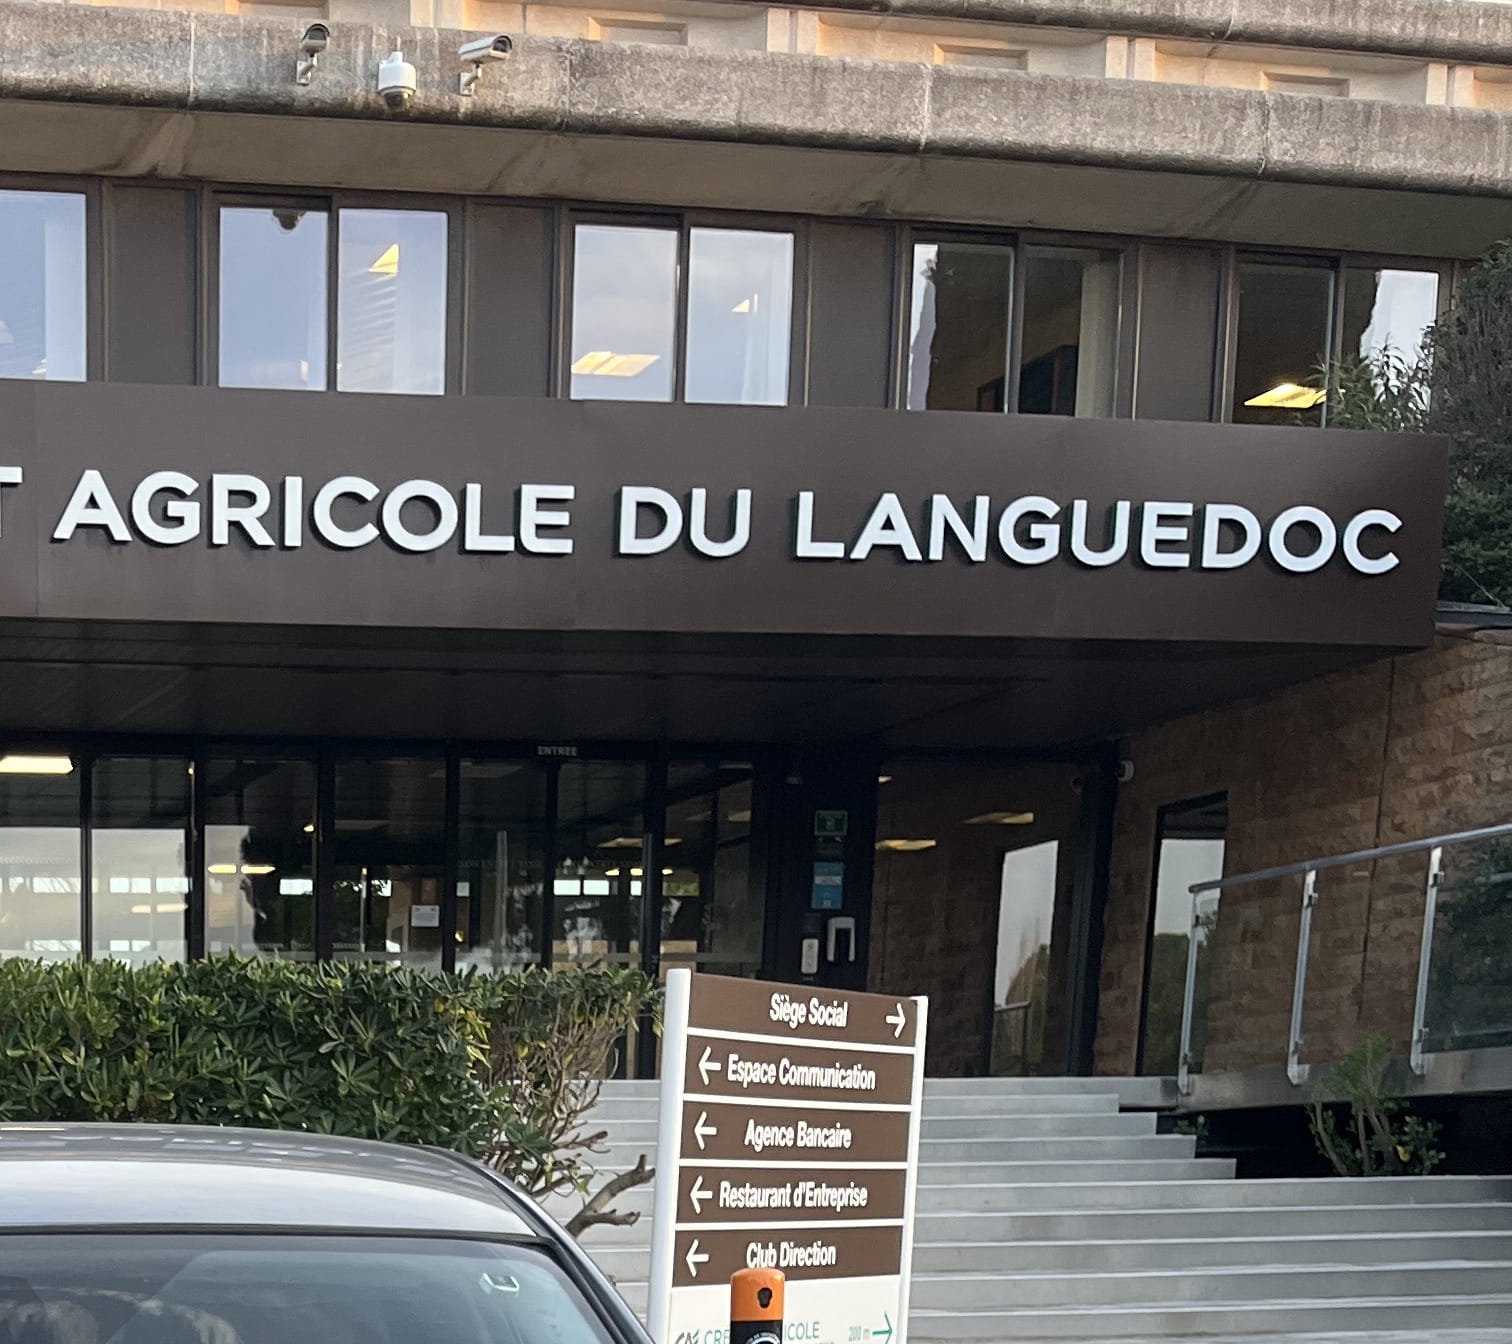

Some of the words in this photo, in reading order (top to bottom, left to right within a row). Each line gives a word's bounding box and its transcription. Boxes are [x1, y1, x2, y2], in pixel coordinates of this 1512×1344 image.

[52, 469, 575, 554] AGRICOLE
[618, 486, 752, 558] DU
[796, 491, 1403, 574] LANGUEDOC
[770, 992, 806, 1029] Siège
[808, 998, 848, 1027] Social
[727, 1054, 776, 1088] Espace
[779, 1057, 875, 1090] Communication
[744, 1119, 794, 1152] Agence
[797, 1121, 852, 1148] Bancaire
[719, 1181, 791, 1208] Restaurant
[793, 1181, 868, 1212] d'Entreprise
[746, 1242, 777, 1268] Club
[780, 1240, 836, 1267] Direction
[783, 1321, 820, 1341] ICOLE
